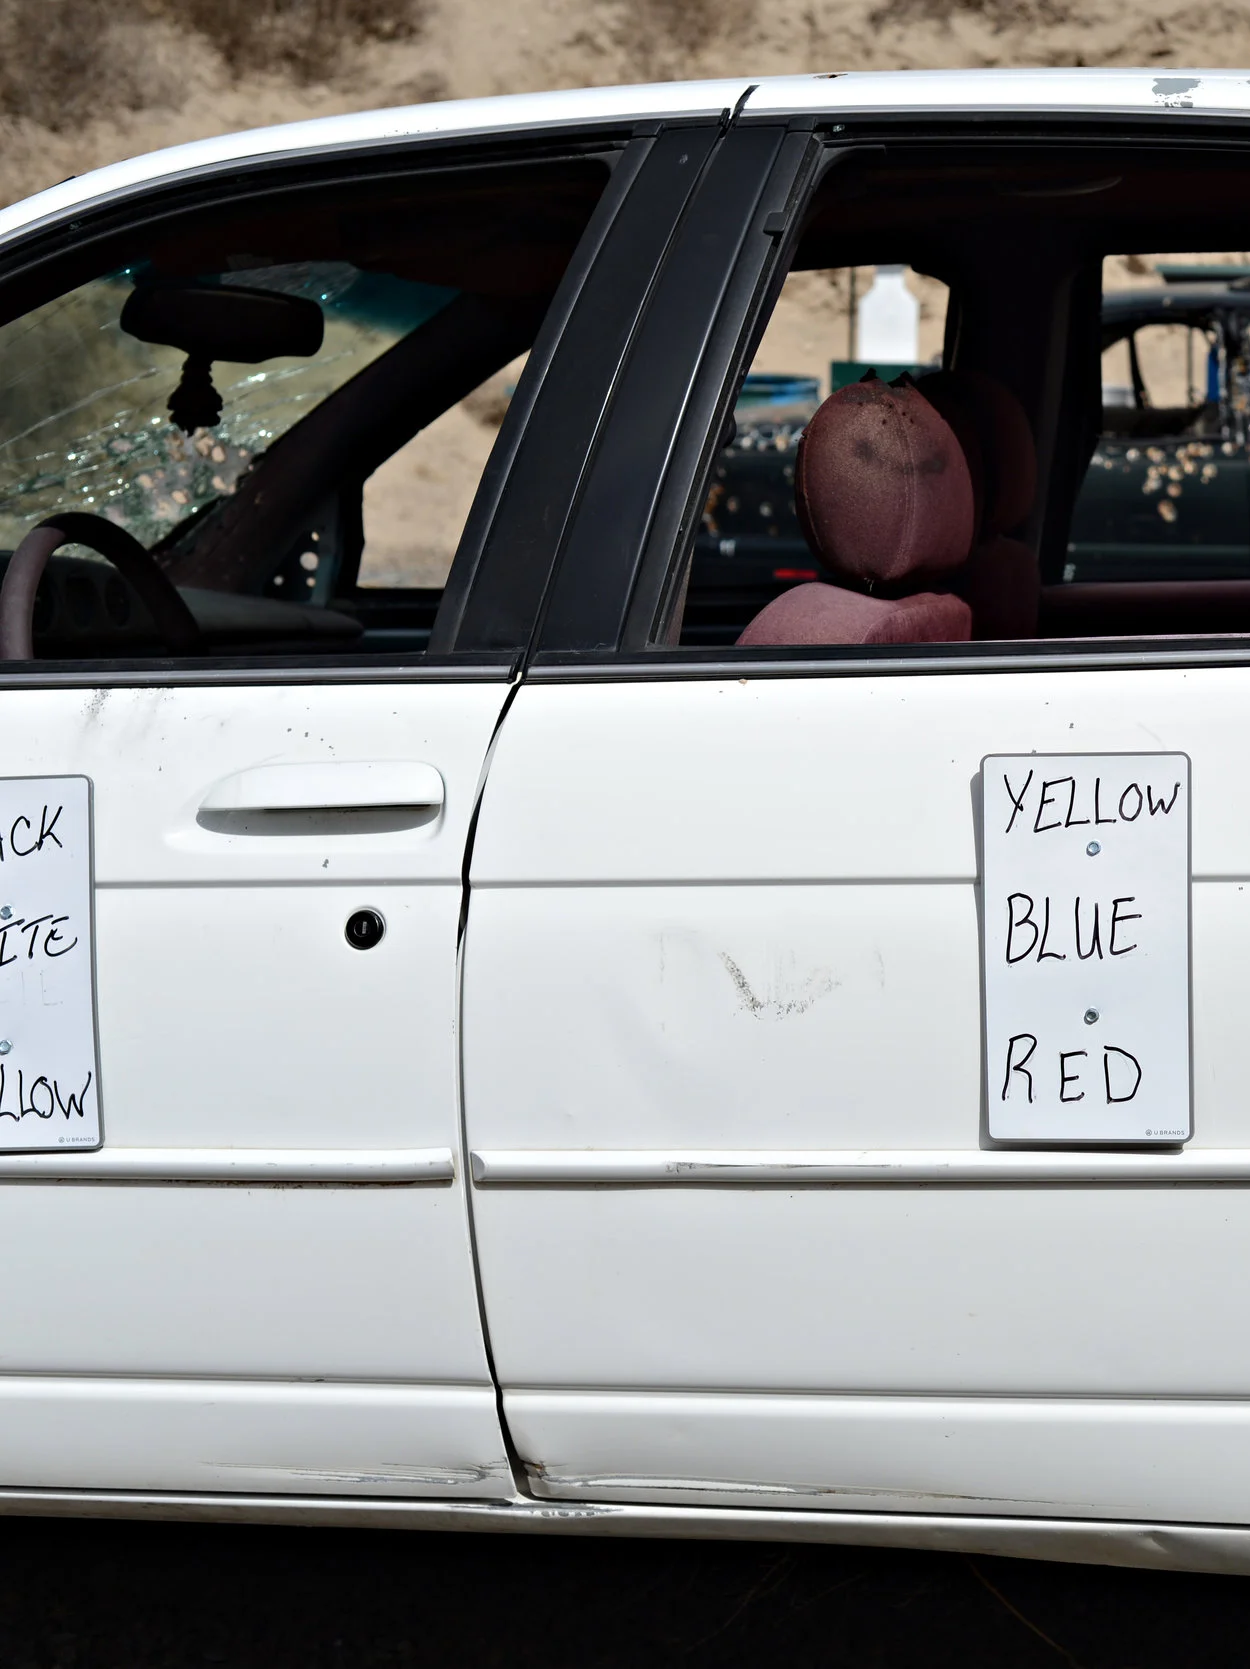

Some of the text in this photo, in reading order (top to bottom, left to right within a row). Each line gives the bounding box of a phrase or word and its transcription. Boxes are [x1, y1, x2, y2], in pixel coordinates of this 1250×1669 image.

[0, 805, 63, 862] CK
[1003, 769, 1181, 834] YELLOW
[1005, 892, 1142, 964] BLUE
[1001, 1033, 1142, 1104] RED
